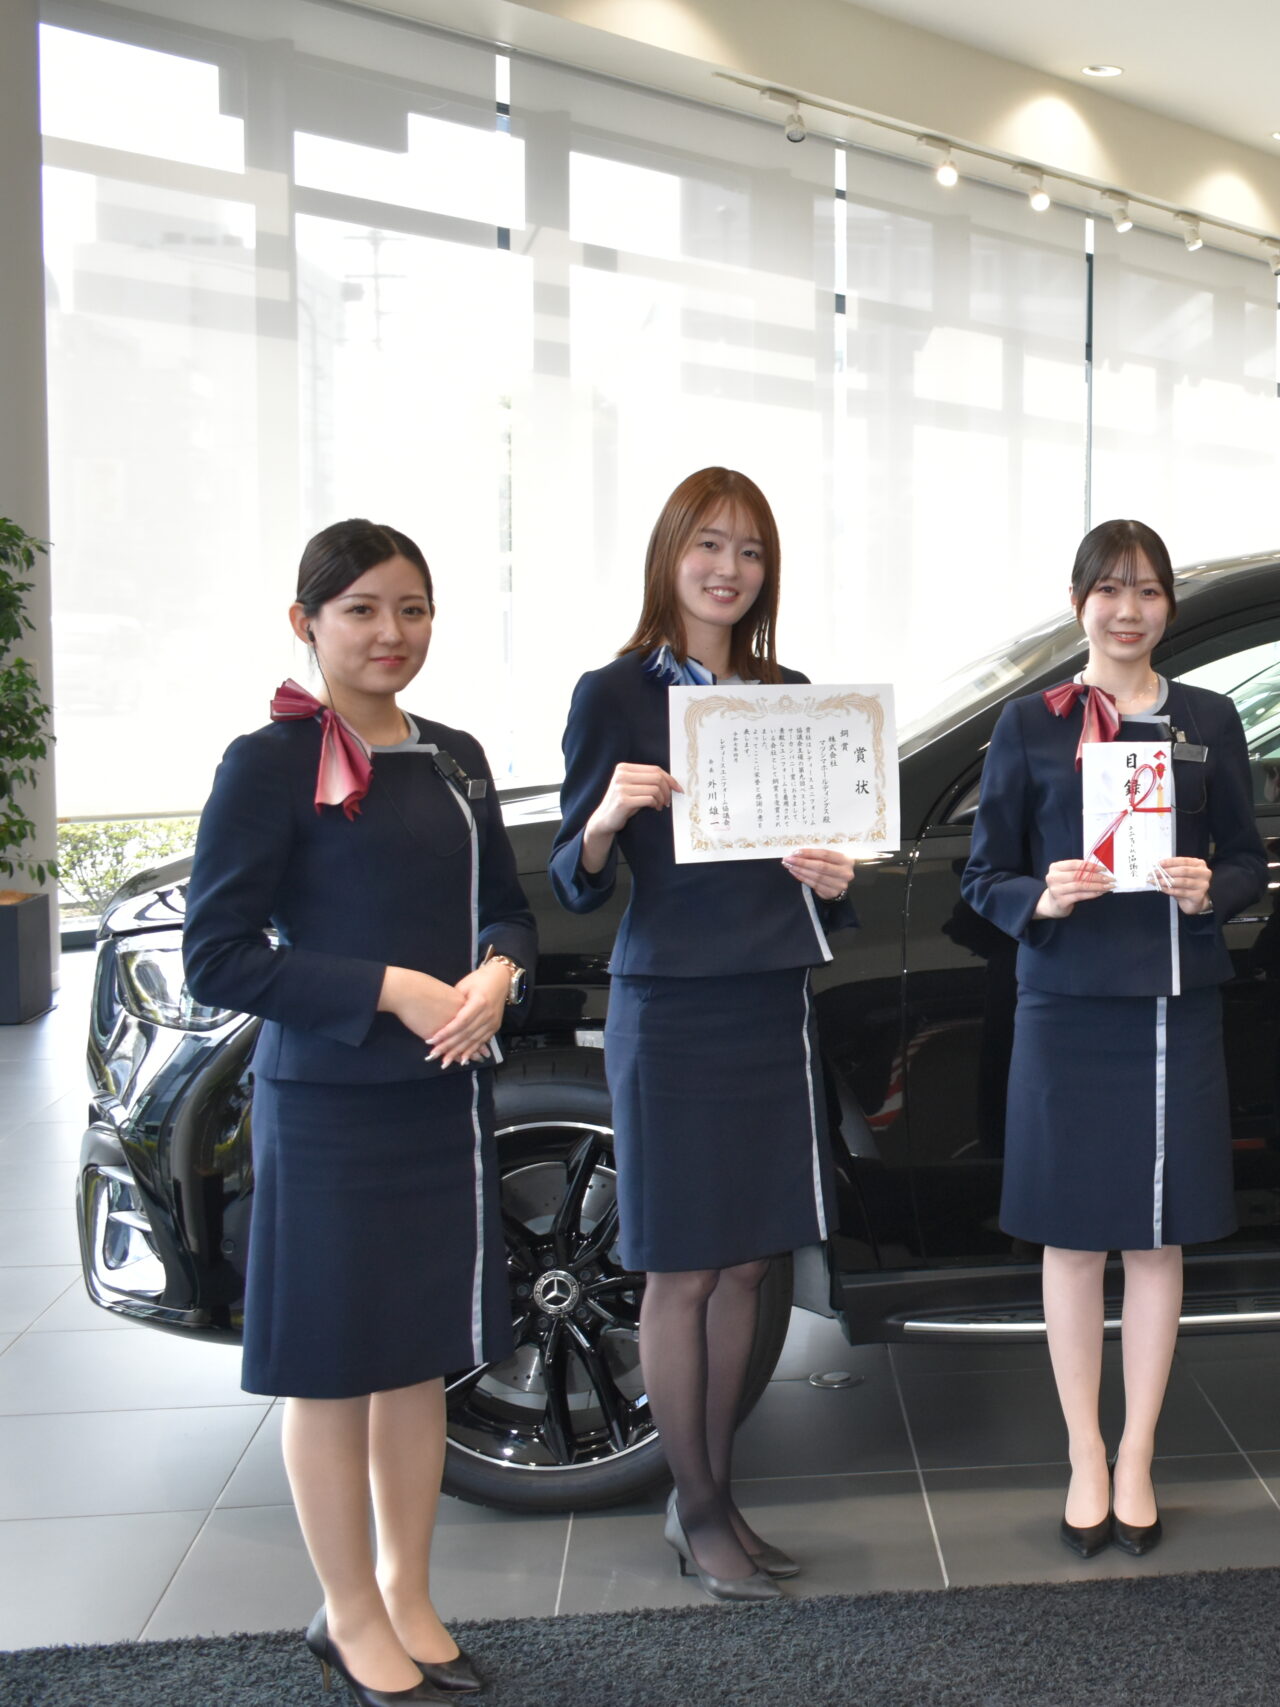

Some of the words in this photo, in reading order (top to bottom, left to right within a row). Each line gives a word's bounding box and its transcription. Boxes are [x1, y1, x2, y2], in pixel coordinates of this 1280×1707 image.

[828, 735, 838, 767] 株式会社
[840, 729, 849, 752] 銅賞
[853, 746, 870, 795] 賞状
